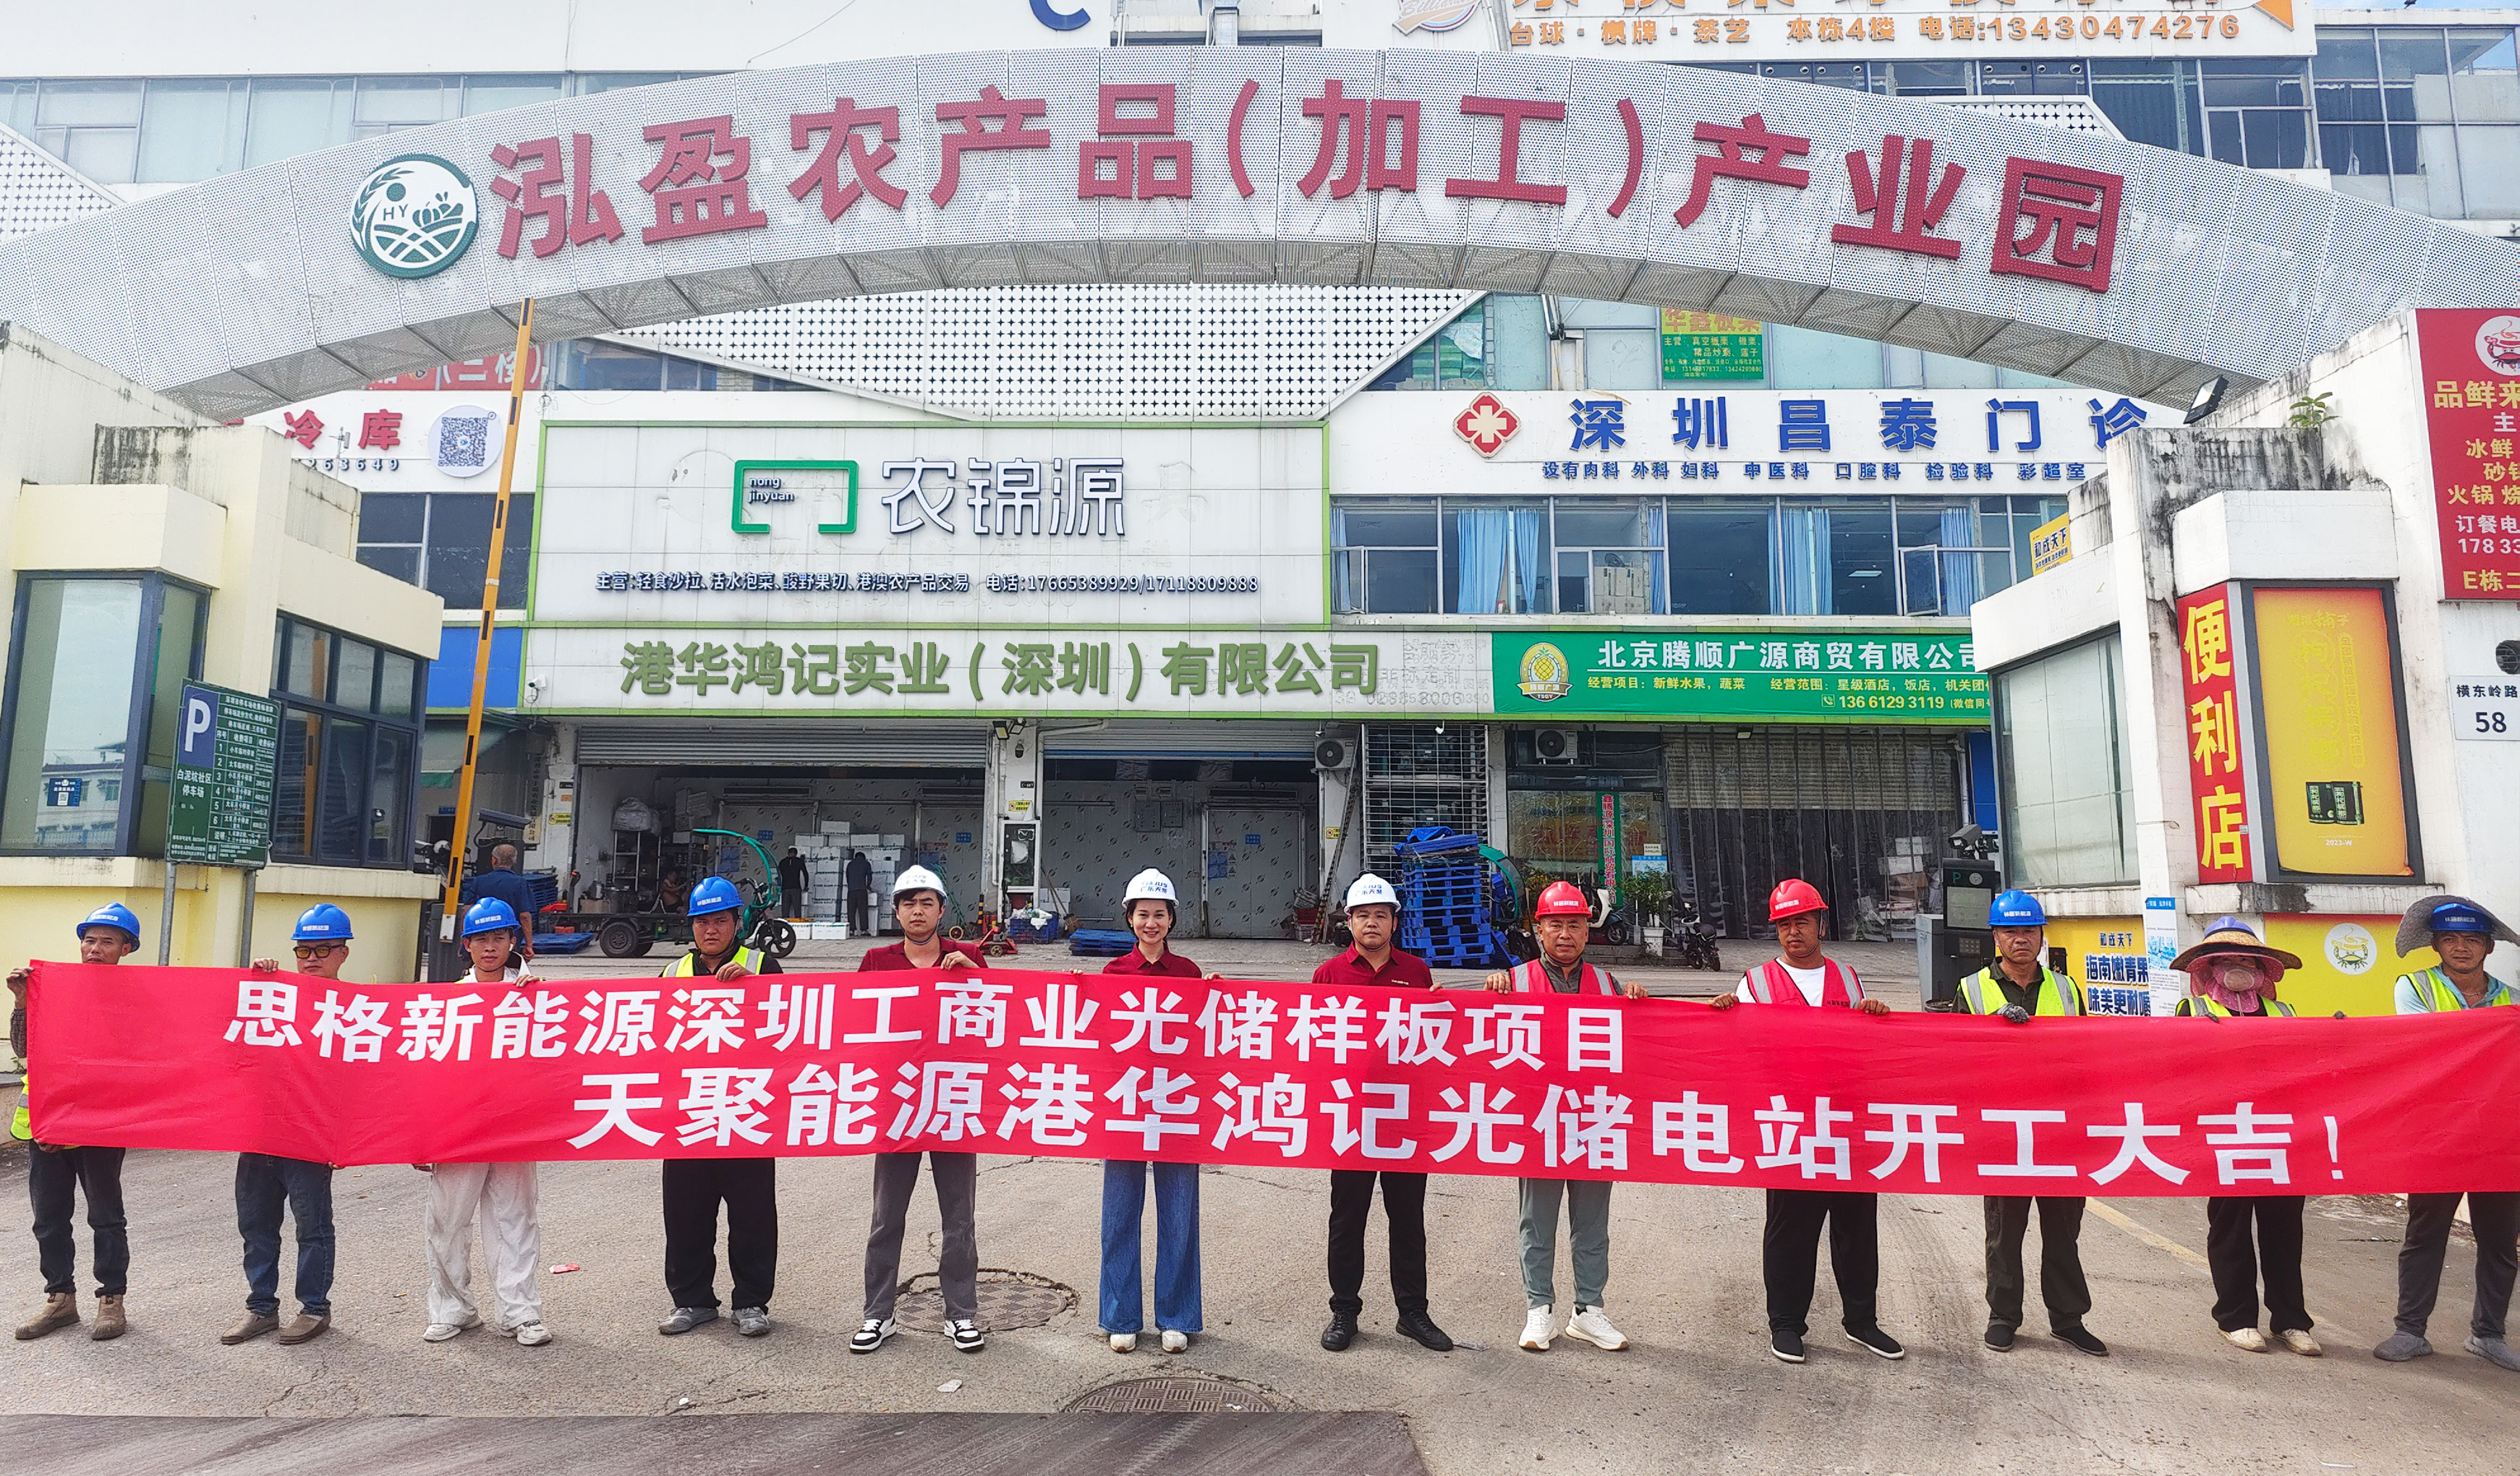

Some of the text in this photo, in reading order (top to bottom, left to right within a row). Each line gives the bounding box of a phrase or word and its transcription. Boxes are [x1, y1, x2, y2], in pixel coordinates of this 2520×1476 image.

[1787, 17, 1896, 42] 本栋4楼
[1919, 14, 2239, 40] 电话:13430474276
[488, 77, 2125, 294] 泓盈农产品（加工）产业园
[284, 409, 403, 450] 冷库
[1568, 396, 2147, 453] 深圳昌泰门诊
[2466, 438, 2513, 458] 冰鲜
[1543, 461, 2086, 479] 设有内科 外科 妇科 中医科 口腔科 检验科 彩超室
[749, 476, 781, 489] nong
[748, 489, 794, 503] jinyuan
[880, 457, 1125, 536] 农锦源
[2447, 485, 2494, 505] 火锅
[2458, 538, 2494, 554] 178
[986, 573, 1259, 594] 电话:17665389929/17118809888
[1597, 640, 1976, 670] 北京腾顺广源商贸有限公司
[621, 641, 1379, 702] 港华鸿记实业（深圳）有限公司
[1770, 678, 1990, 691] 经营范围：星级酒店，饭店，机关团
[2456, 684, 2519, 699] 横东岭路
[1839, 696, 1866, 709] 136
[1868, 696, 1905, 709] 6129
[1908, 696, 1944, 709] 3119
[184, 698, 211, 752] P
[2475, 712, 2507, 733] 58
[2183, 599, 2244, 869] 便利店
[218, 743, 223, 752] 1
[217, 757, 223, 767] 2
[177, 768, 212, 784] 白泥坑社区
[216, 772, 222, 781] 3
[182, 785, 205, 798] 停车场
[215, 786, 221, 795] 4
[214, 801, 219, 810] 5
[213, 816, 218, 824] 6
[2100, 931, 2132, 947] 和成天下
[2086, 955, 2149, 983] 海南嫩青果
[223, 980, 1625, 1075] 思格新能源深圳工商业光储样板项目
[566, 1061, 2344, 1186] 天聚能源港华鸿记光储电站开工大吉！
